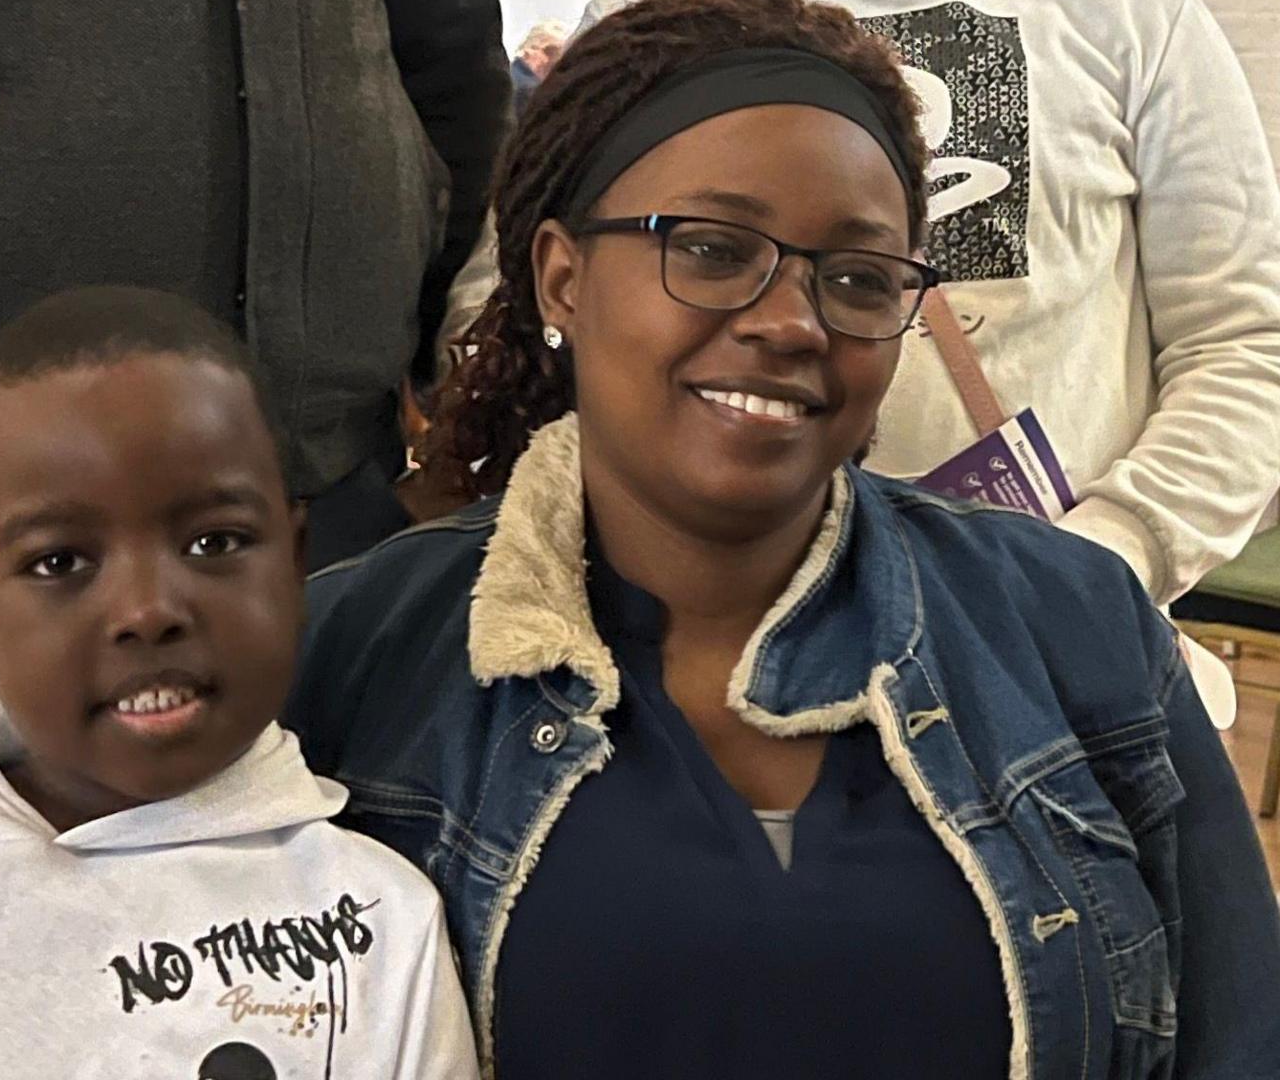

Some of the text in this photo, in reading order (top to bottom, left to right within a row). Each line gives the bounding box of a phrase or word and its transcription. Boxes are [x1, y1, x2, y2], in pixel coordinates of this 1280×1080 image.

[109, 893, 381, 1013] NO THANKS
[216, 984, 343, 1027] Birminghm
